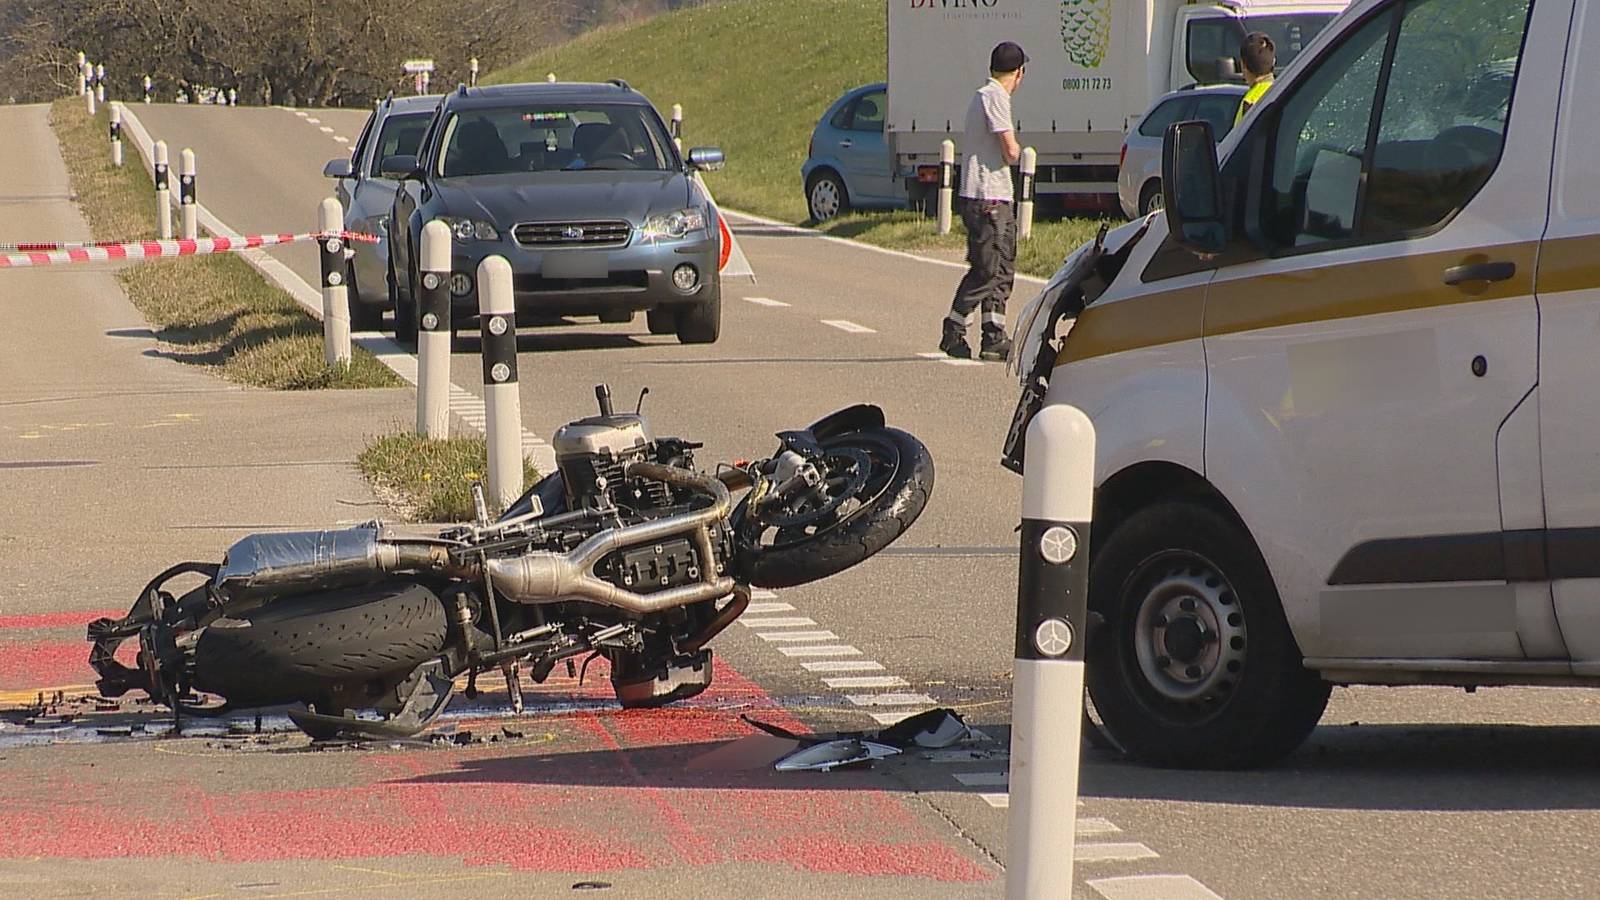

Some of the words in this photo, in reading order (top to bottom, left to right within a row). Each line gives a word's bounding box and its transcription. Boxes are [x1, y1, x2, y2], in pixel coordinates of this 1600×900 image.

[1062, 78, 1080, 90] 0800
[1082, 78, 1089, 90] 71
[1092, 78, 1101, 90] 72
[1103, 78, 1111, 90] 73
